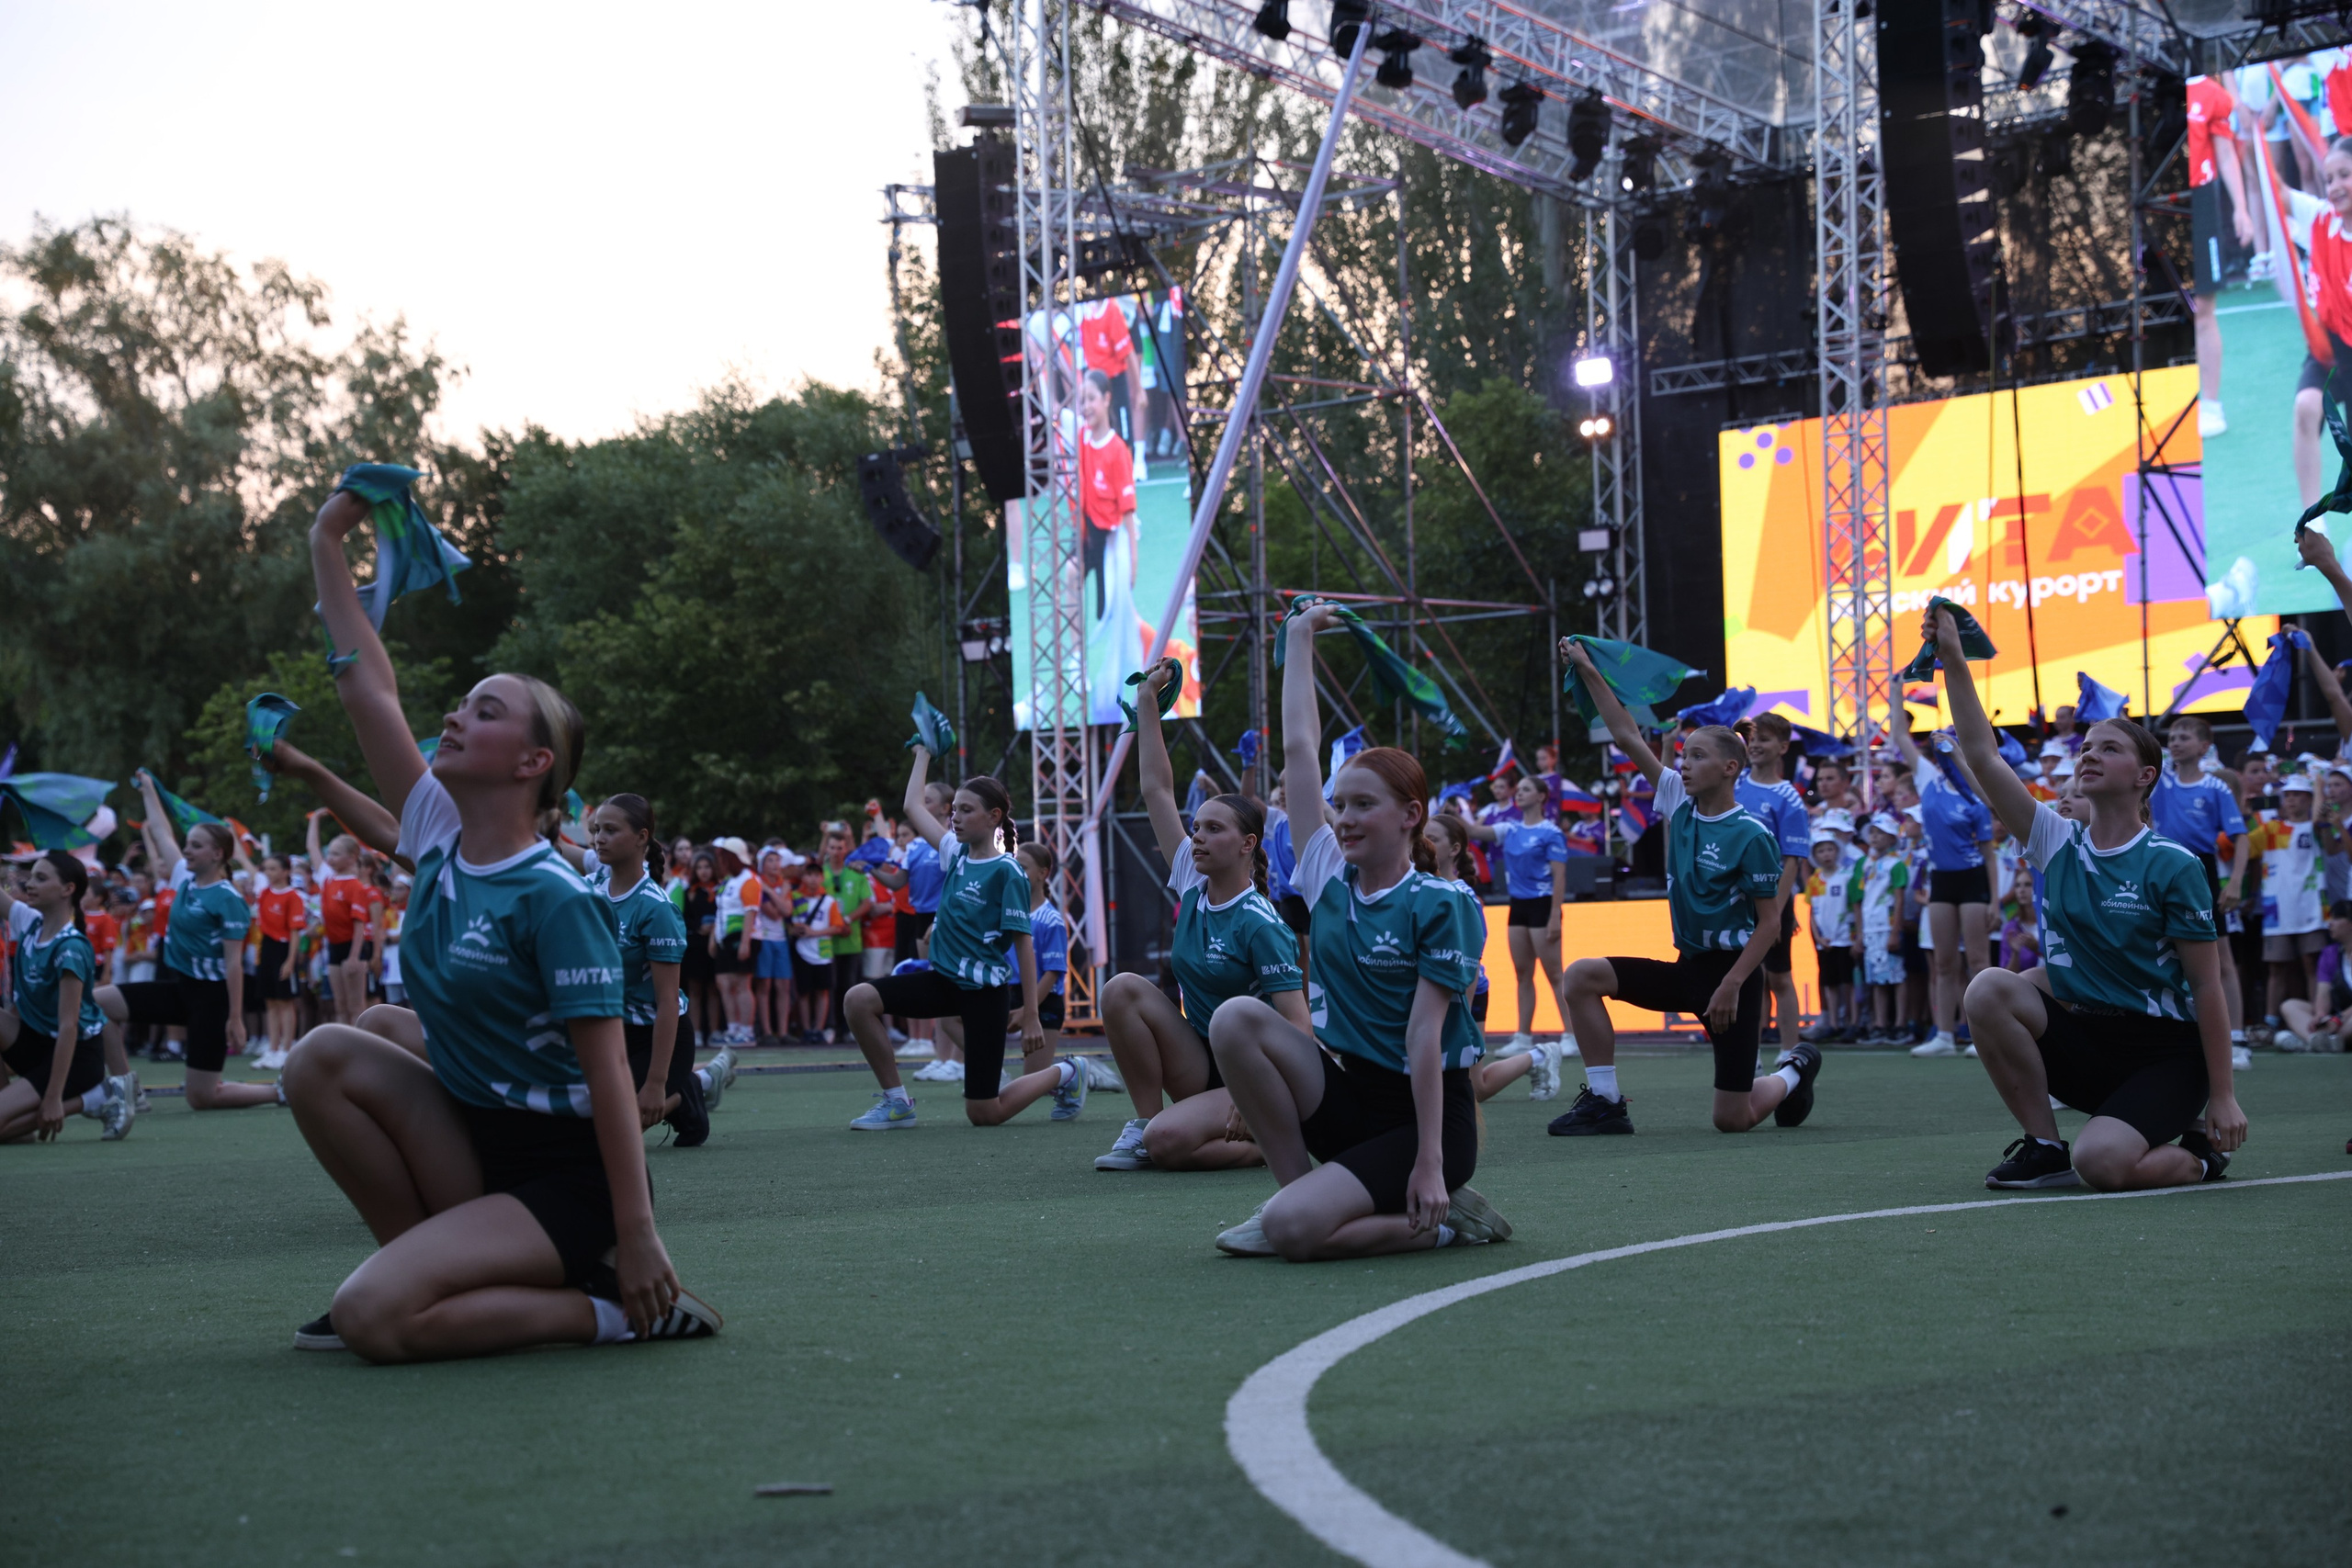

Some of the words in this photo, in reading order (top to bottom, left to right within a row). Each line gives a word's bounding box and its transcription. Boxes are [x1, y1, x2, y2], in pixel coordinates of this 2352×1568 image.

[1988, 569, 2123, 610] курорт
[650, 938, 677, 947] ВИТА
[555, 967, 613, 987] ВИТА
